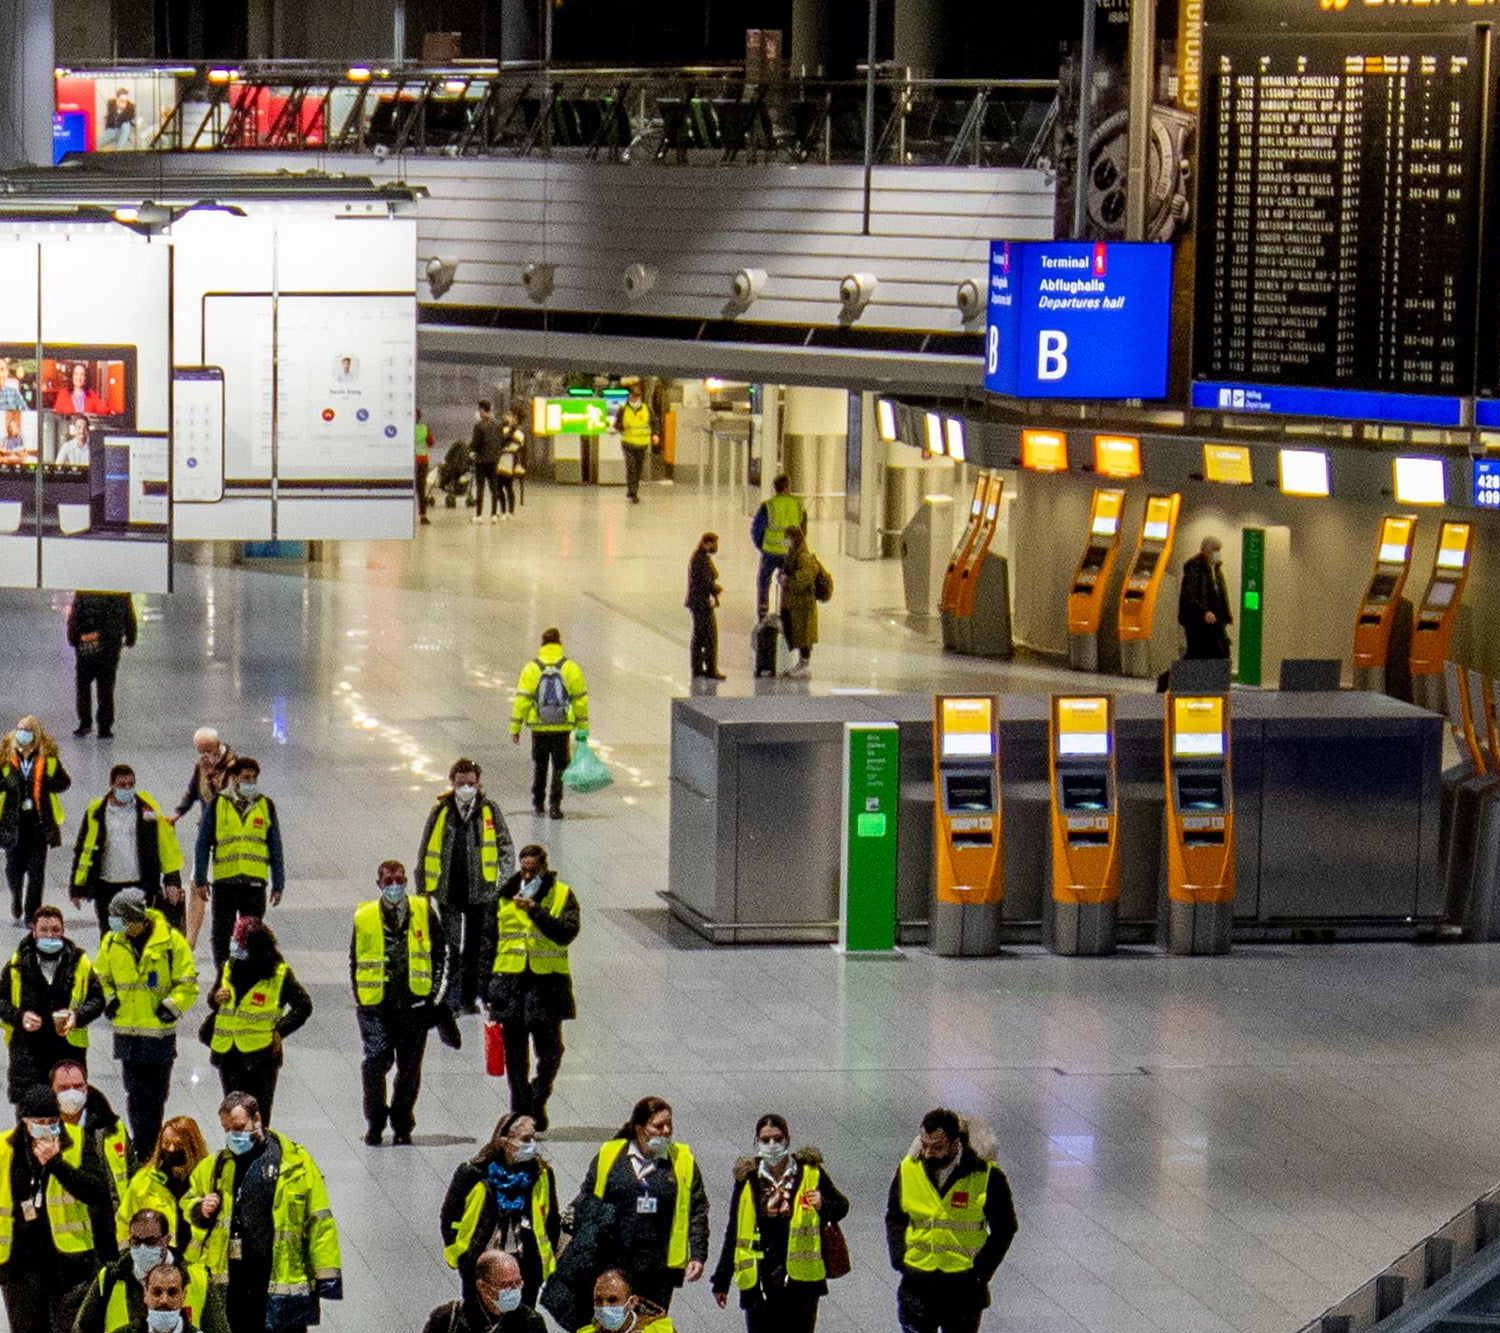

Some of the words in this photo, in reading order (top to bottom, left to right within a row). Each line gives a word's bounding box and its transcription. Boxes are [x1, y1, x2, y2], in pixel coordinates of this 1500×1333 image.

[1041, 255, 1089, 269] Terminal
[1040, 278, 1105, 293] Abflughalle
[1038, 296, 1100, 310] Departures
[1102, 296, 1125, 309] hall
[1038, 330, 1068, 381] B
